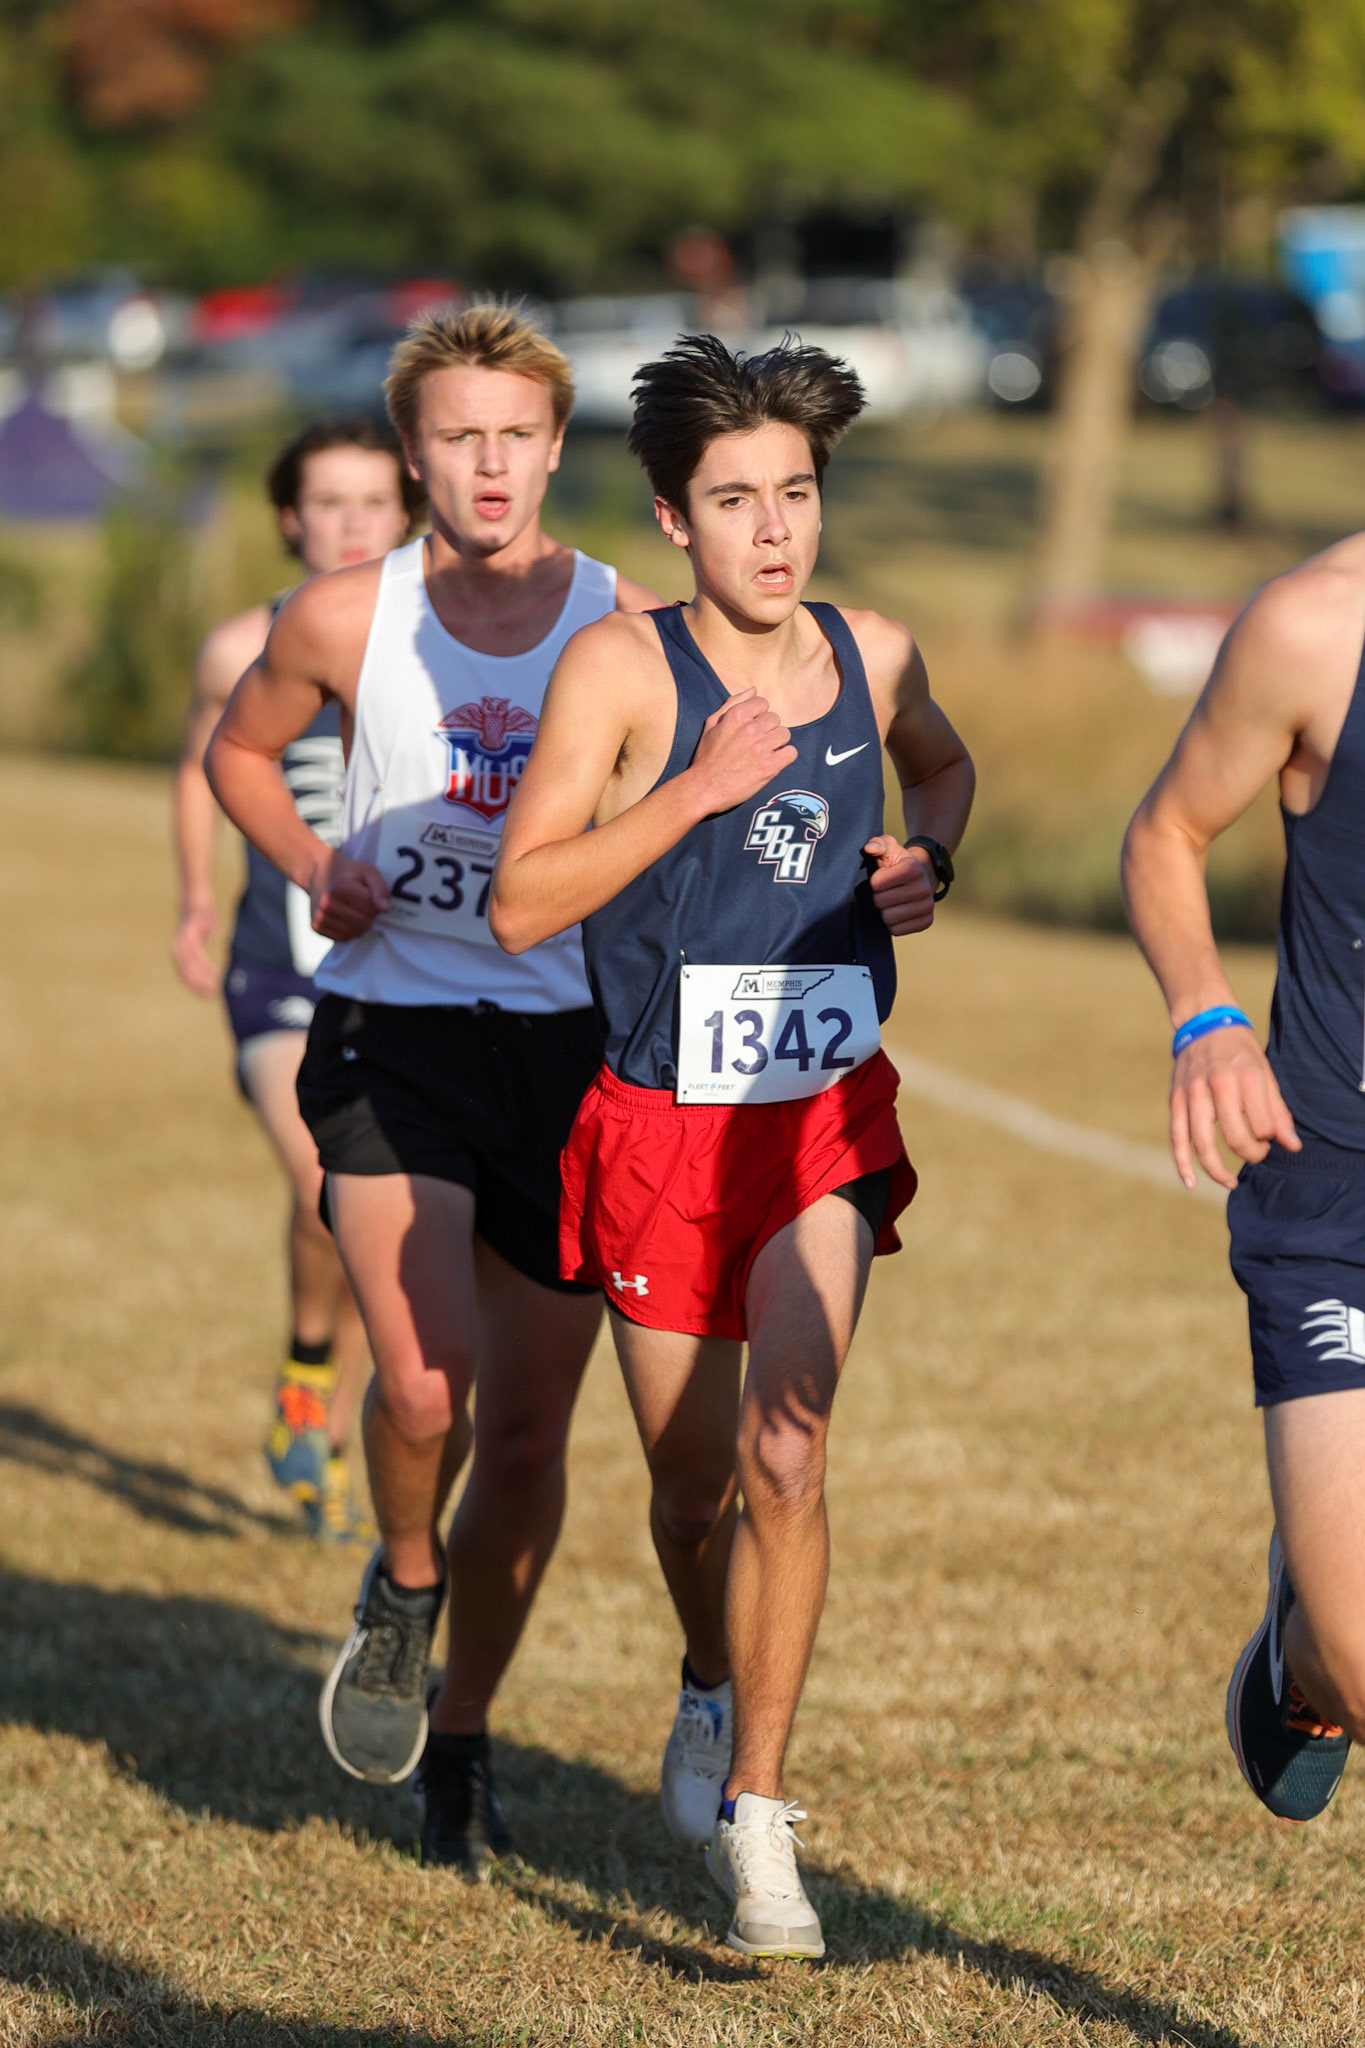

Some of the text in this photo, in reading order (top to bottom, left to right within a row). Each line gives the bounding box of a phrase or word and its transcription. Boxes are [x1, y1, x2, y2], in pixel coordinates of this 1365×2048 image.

[749, 810, 813, 878] SBA
[741, 979, 760, 992] M
[766, 979, 803, 987] MEMPHIS
[704, 1007, 856, 1076] 1342
